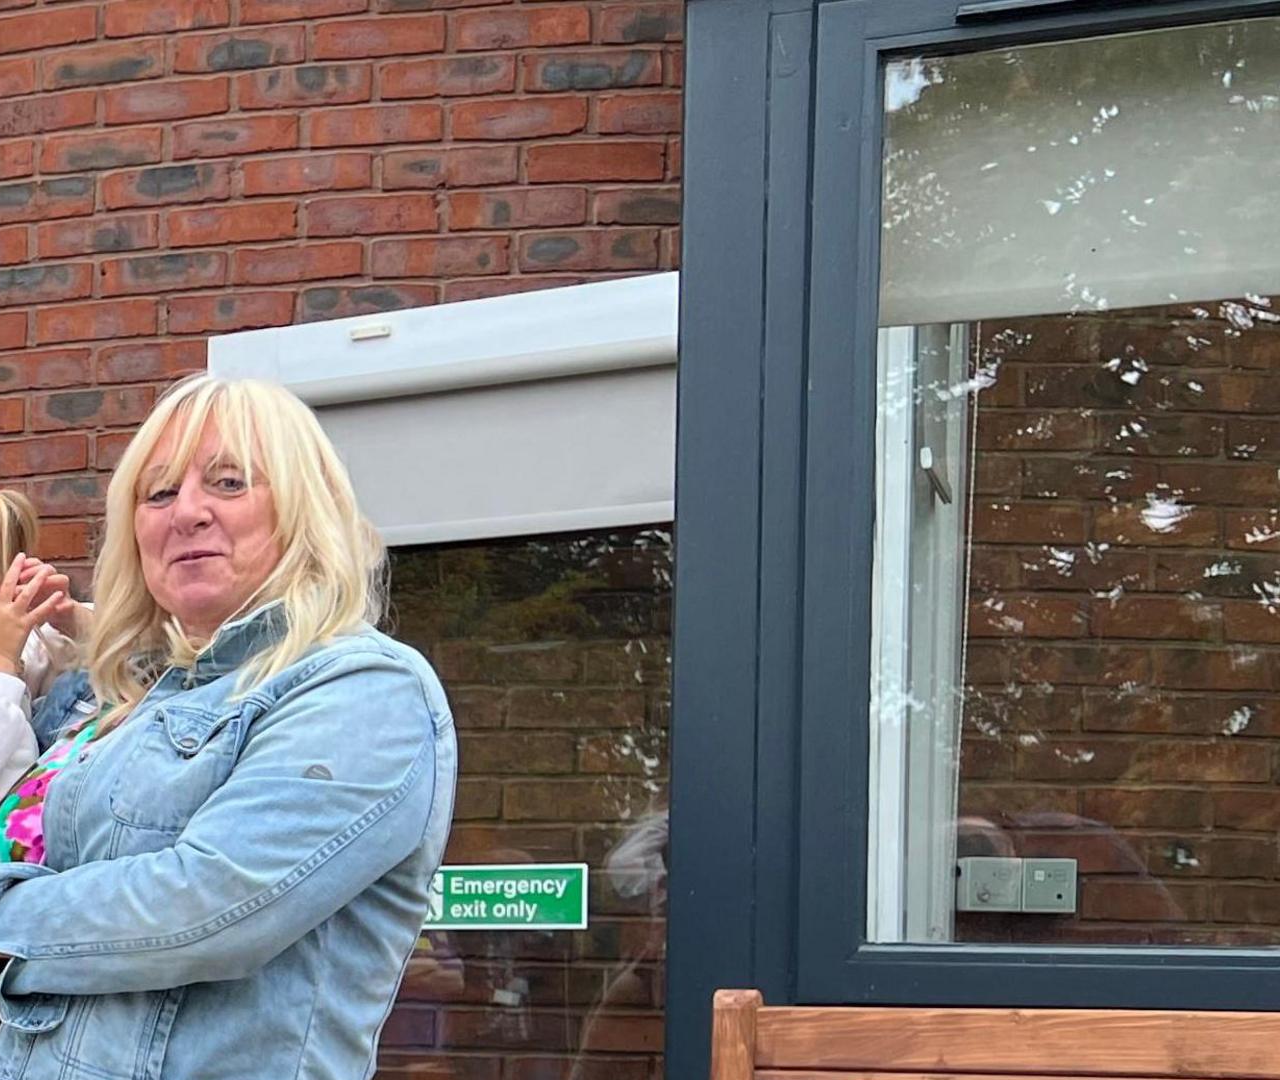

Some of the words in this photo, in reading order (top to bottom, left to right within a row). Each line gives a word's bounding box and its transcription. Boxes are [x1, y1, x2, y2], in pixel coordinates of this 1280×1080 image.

[450, 876, 567, 899] Emergency
[450, 901, 487, 918] exit
[493, 900, 537, 922] only
